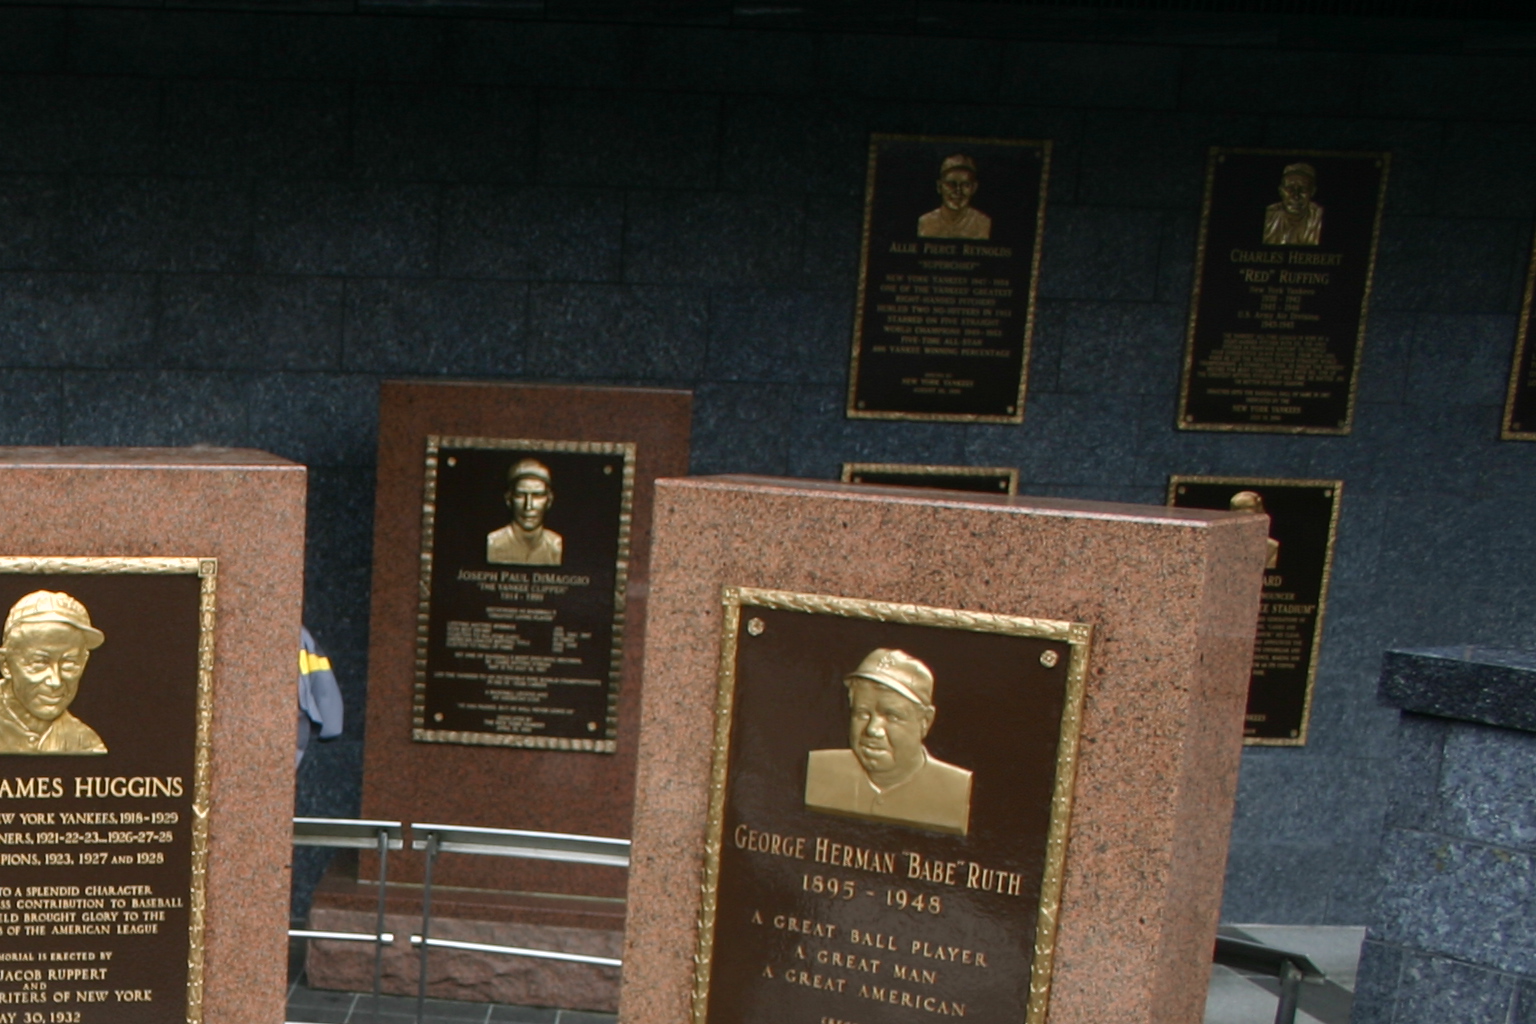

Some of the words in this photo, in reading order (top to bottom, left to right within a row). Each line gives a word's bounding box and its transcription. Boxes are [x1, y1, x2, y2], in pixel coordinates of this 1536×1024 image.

[1230, 248, 1284, 264] CHARLES
[1288, 250, 1343, 266] HERBERT
[1239, 268, 1276, 283] "RED"
[1279, 269, 1329, 285] RUFFING
[75, 776, 183, 798] HUGGINS
[19, 812, 55, 825] YORK
[119, 811, 179, 824] 1918-1929
[79, 852, 109, 865] 1927
[111, 855, 134, 865] AND
[137, 852, 164, 864] 1928
[735, 824, 806, 859] GEORGE
[815, 837, 895, 874] HERMAN
[902, 851, 965, 885] "BABE"
[966, 861, 1021, 896] RUTH
[14, 887, 23, 897] A
[26, 886, 80, 897] SPLENDID
[84, 885, 153, 896] CHARACTER
[802, 874, 855, 899] 1895
[886, 888, 941, 914] 1948
[16, 898, 104, 910] CONTRIBUTION
[110, 898, 127, 909] TO
[131, 897, 182, 909] BASEBALL
[23, 911, 77, 923] BROUGHT
[81, 911, 119, 922] GLORY
[123, 911, 139, 922] TO
[142, 910, 165, 922] THE
[6, 925, 21, 936] OF
[24, 925, 46, 936] THE
[51, 924, 111, 935] AMERICAN
[116, 923, 158, 935] LEAGUE
[751, 910, 763, 926] A
[773, 915, 836, 938] GREAT
[850, 929, 897, 951] BALL
[911, 940, 986, 968] PLAYER
[38, 952, 47, 961] IS
[50, 951, 96, 961] ERECTED
[99, 951, 113, 961] BY
[794, 944, 806, 961] A
[816, 949, 881, 974] GREAT
[893, 963, 936, 985] MAN
[48, 968, 108, 981] RUPPERT
[22, 981, 48, 991] AND
[762, 966, 773, 979] A
[785, 969, 846, 993] GREAT
[860, 984, 965, 1017] AMERICAN
[53, 991, 71, 1003] OF
[76, 990, 109, 1003] NEW
[114, 989, 152, 1002] YORK
[23, 1011, 46, 1024] 30,
[50, 1011, 81, 1024] 1932
